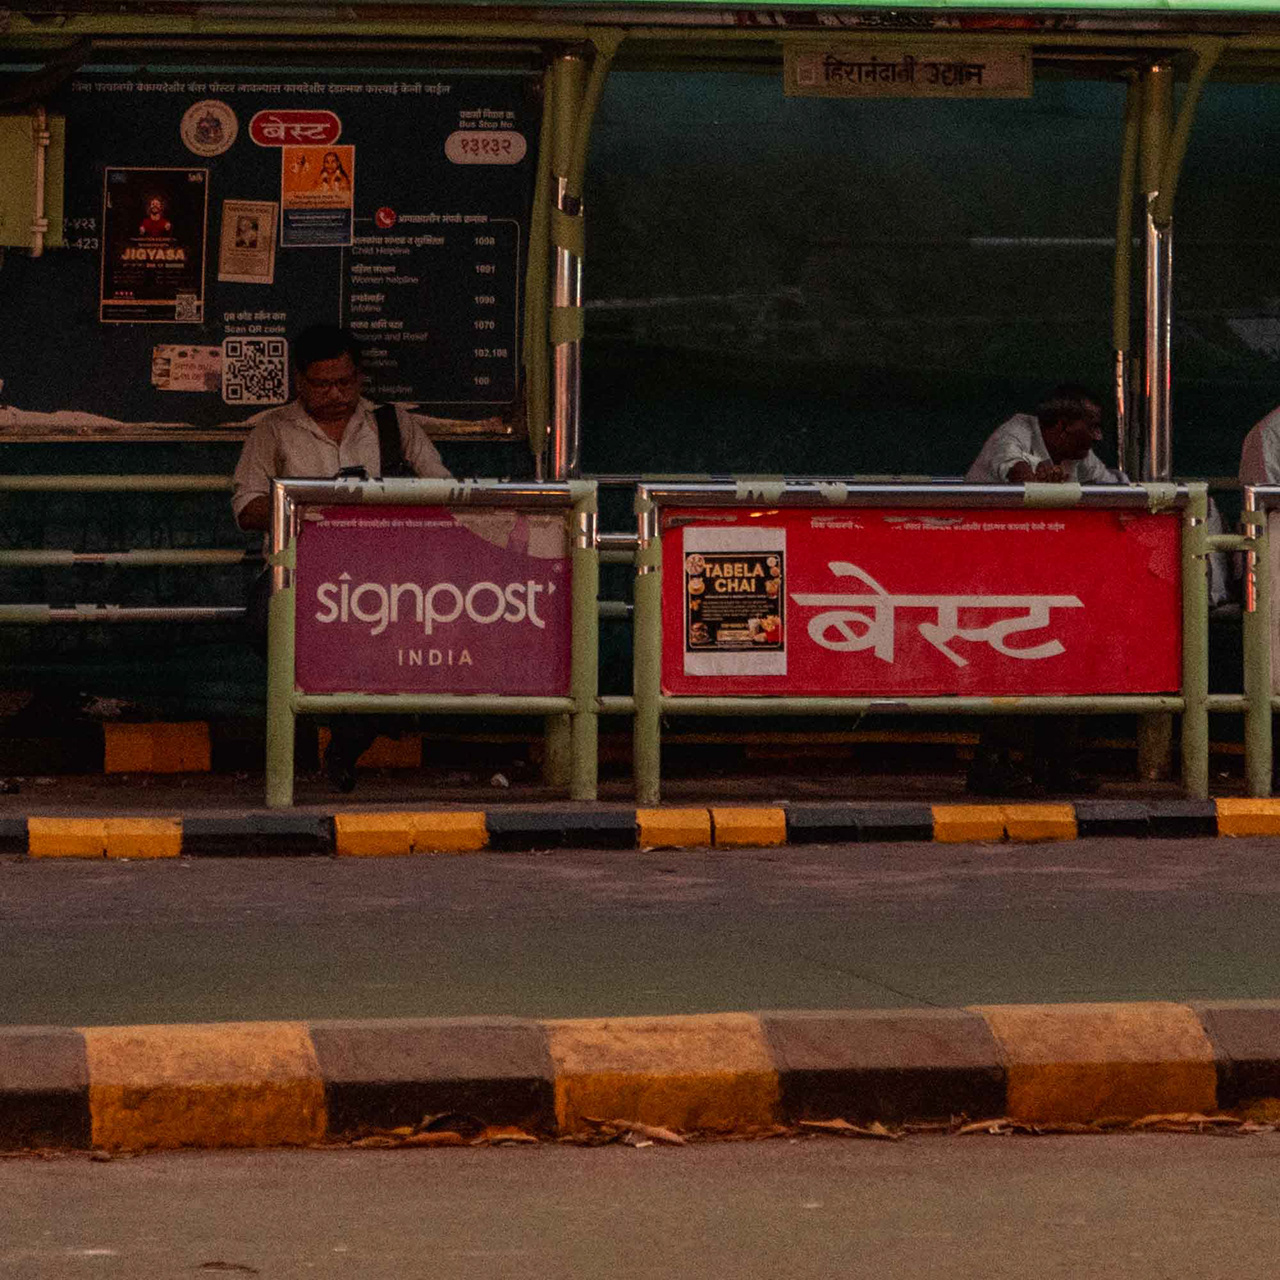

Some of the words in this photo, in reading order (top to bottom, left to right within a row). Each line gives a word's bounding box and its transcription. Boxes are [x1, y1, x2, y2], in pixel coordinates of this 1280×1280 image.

[261, 115, 331, 141] बेस्ट
[479, 121, 498, 129] Stop
[121, 247, 185, 260] JIGYASA
[225, 325, 246, 333] Scan
[248, 325, 262, 333] QR
[264, 325, 286, 333] code
[474, 321, 495, 329] 1070
[703, 562, 764, 577] TABELA
[714, 578, 756, 593] CHAI
[316, 572, 545, 635] signpost
[791, 561, 1085, 668] बेस्ट
[398, 649, 473, 666] INDIA
